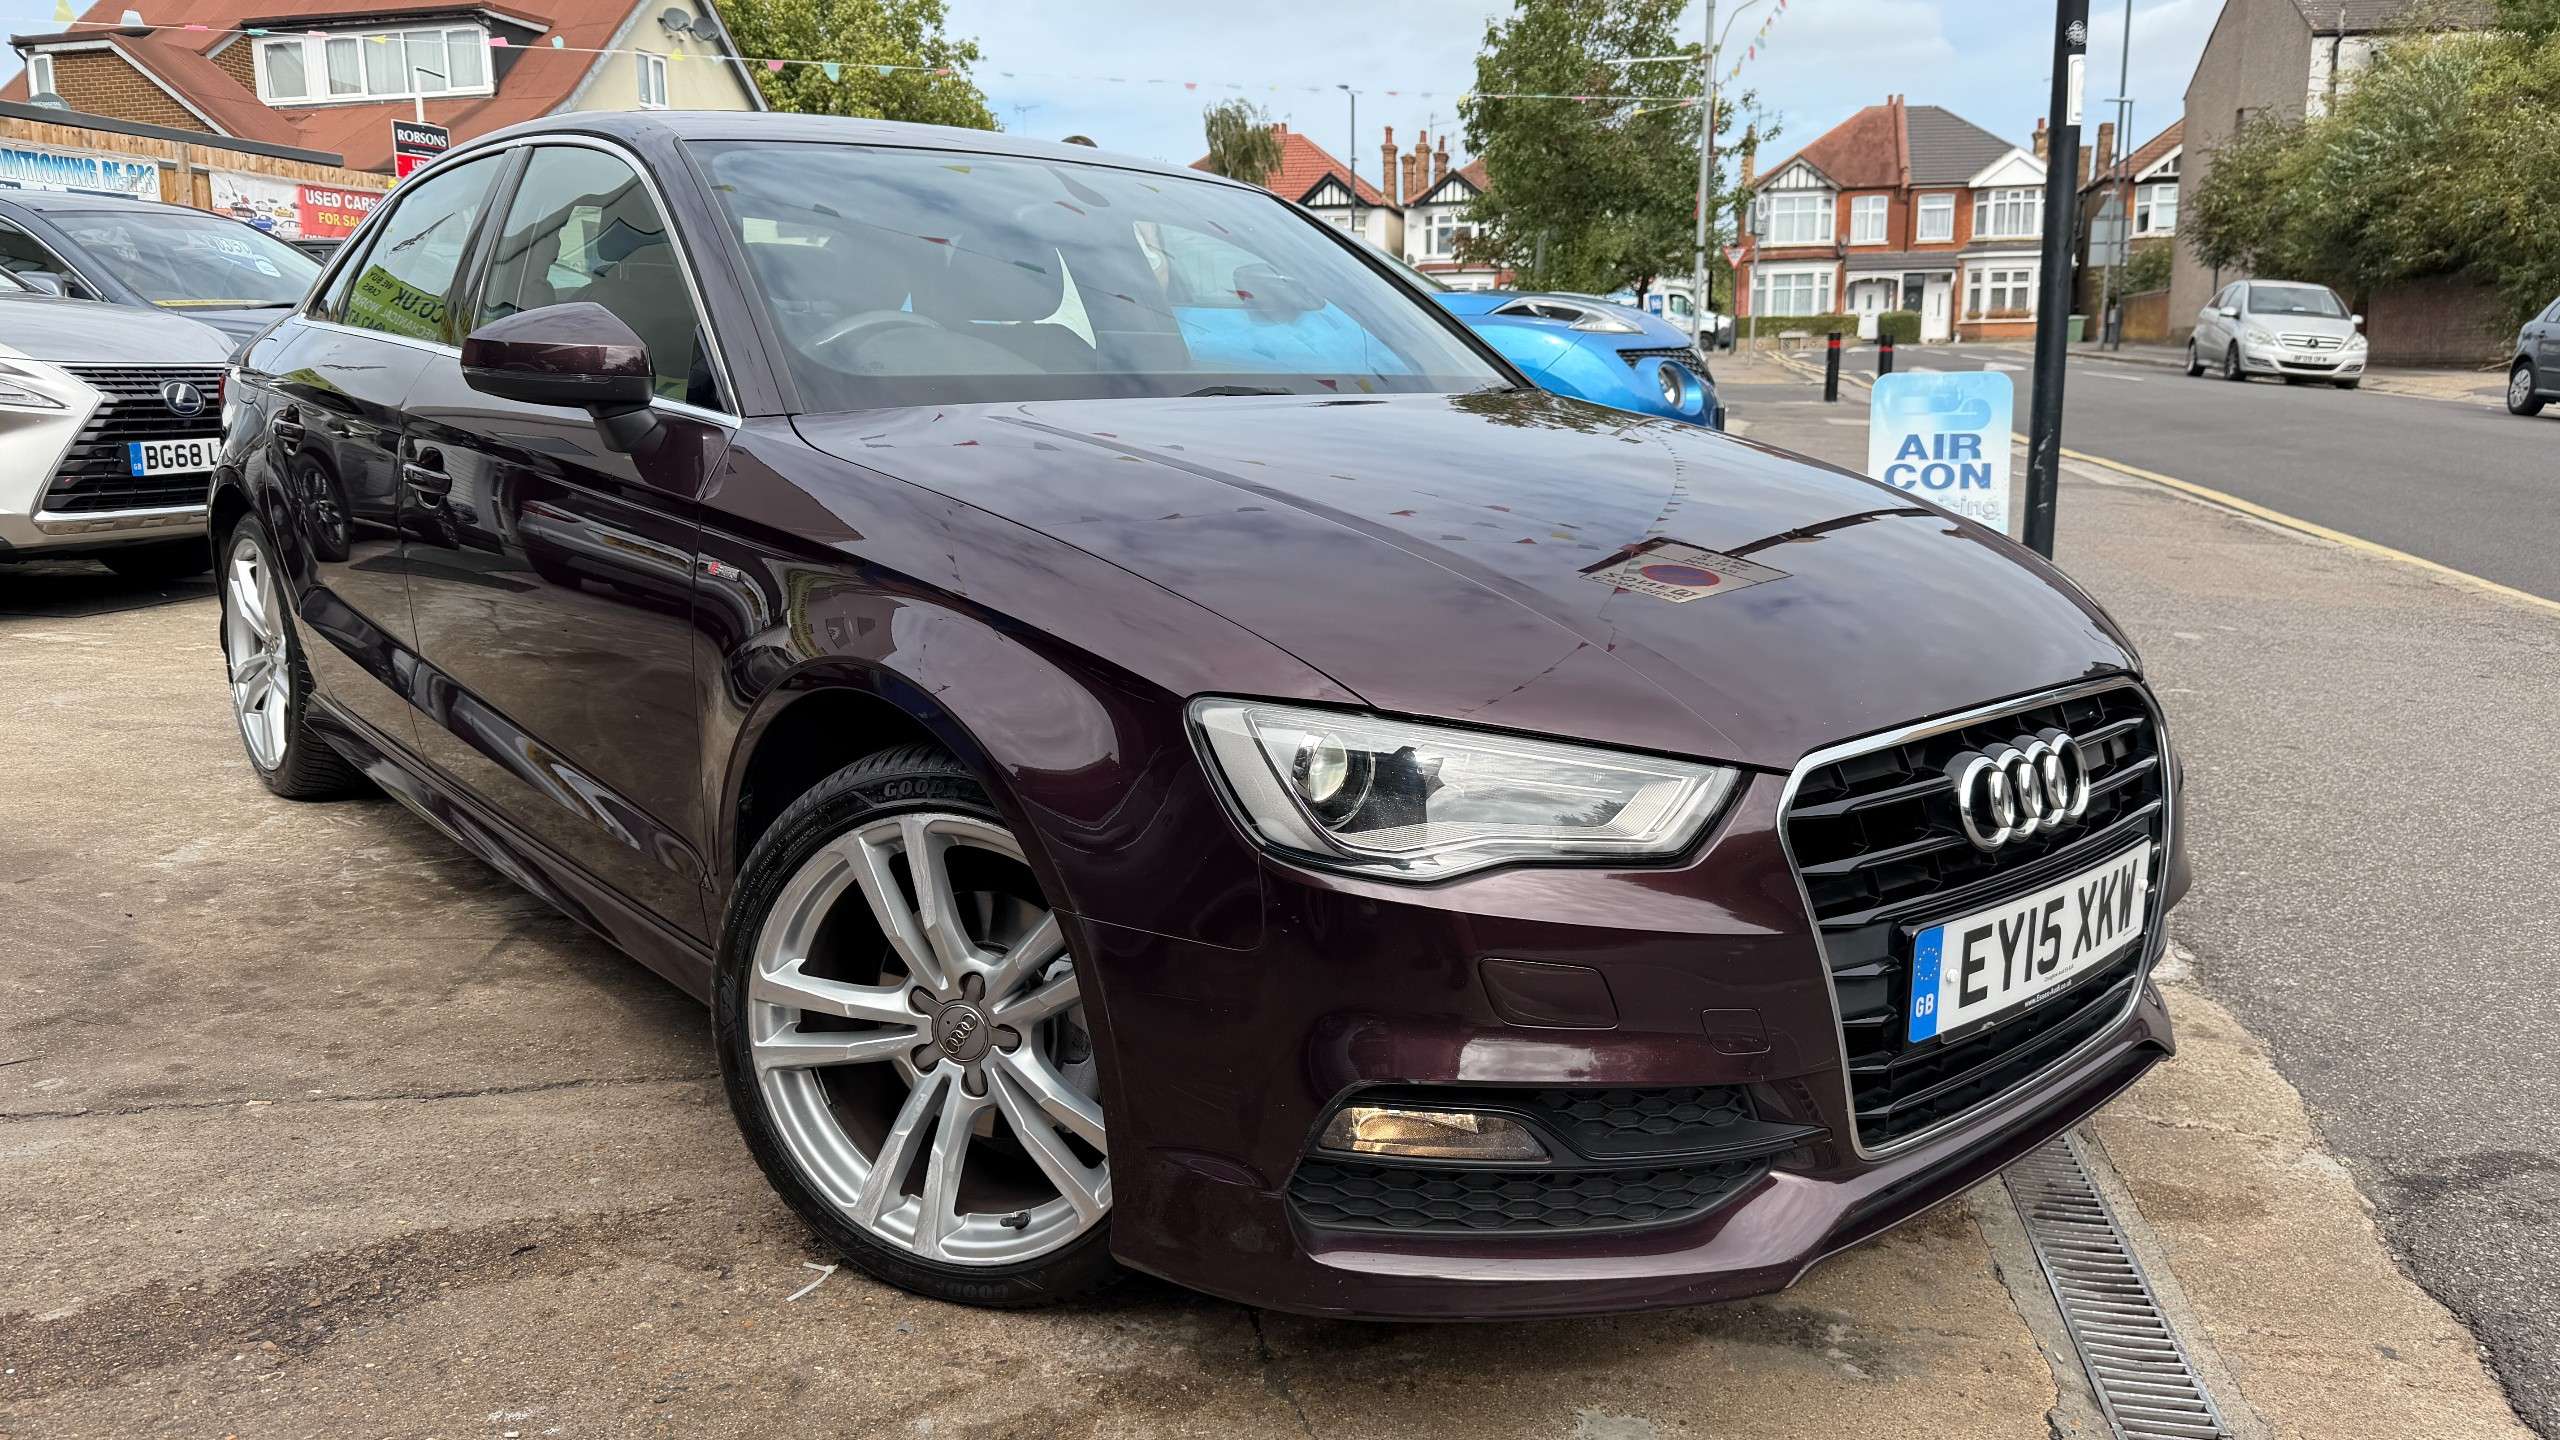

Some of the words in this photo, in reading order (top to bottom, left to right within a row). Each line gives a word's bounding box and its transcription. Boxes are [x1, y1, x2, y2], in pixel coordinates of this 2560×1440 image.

[397, 129, 447, 147] ROBSONS
[0, 148, 98, 188] DITIONING
[305, 189, 341, 208] USED
[344, 194, 378, 212] CARS
[318, 211, 340, 226] FOR
[145, 443, 203, 470] BG68
[207, 442, 218, 466] L
[1894, 433, 1982, 460] AIR
[1884, 462, 1992, 490] CON
[884, 780, 945, 798] GOOD
[1958, 895, 2065, 1009] EY15
[2072, 858, 2138, 960] XKW
[1915, 993, 1934, 1017] GB
